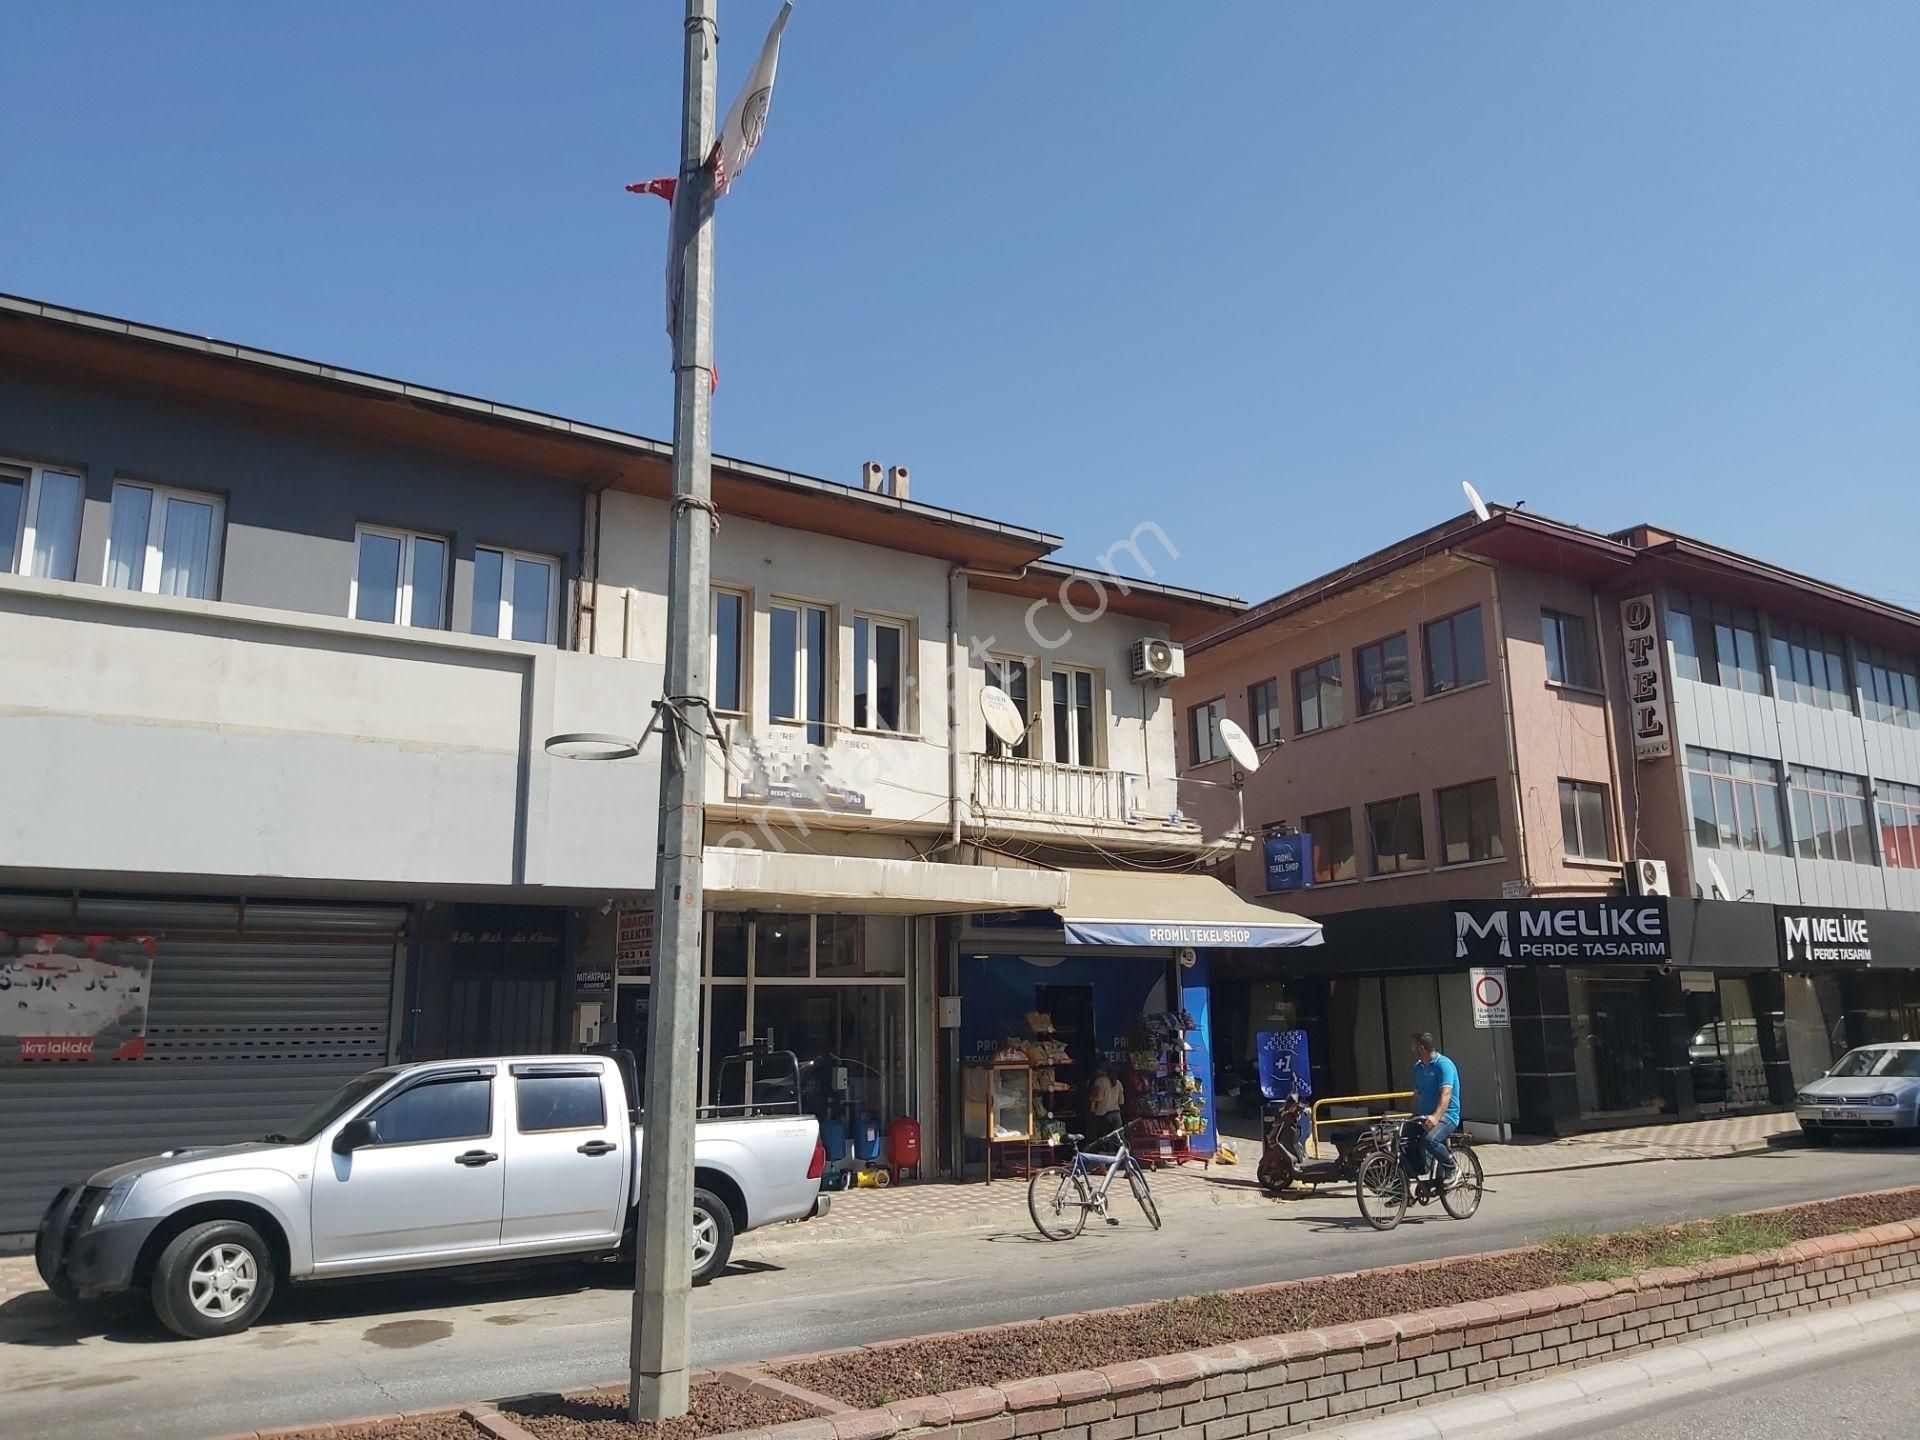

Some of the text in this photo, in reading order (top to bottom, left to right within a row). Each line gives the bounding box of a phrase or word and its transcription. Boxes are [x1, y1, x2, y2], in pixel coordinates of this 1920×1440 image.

[1626, 602, 1663, 738] OTEL
[1270, 862, 1300, 873] TEKEL SHOP
[1519, 903, 1662, 937] MELİKE
[621, 928, 653, 941] ELEKTR
[1150, 926, 1250, 943] PROMİL TEKEL SHOP
[1812, 913, 1869, 943] MELİKE
[1519, 942, 1666, 957] PERDE TASARIM
[1814, 948, 1872, 960] PERDE TASARIM
[977, 1041, 998, 1052] PRO
[1113, 1037, 1129, 1049] PR
[1103, 1051, 1128, 1063] TEKE
